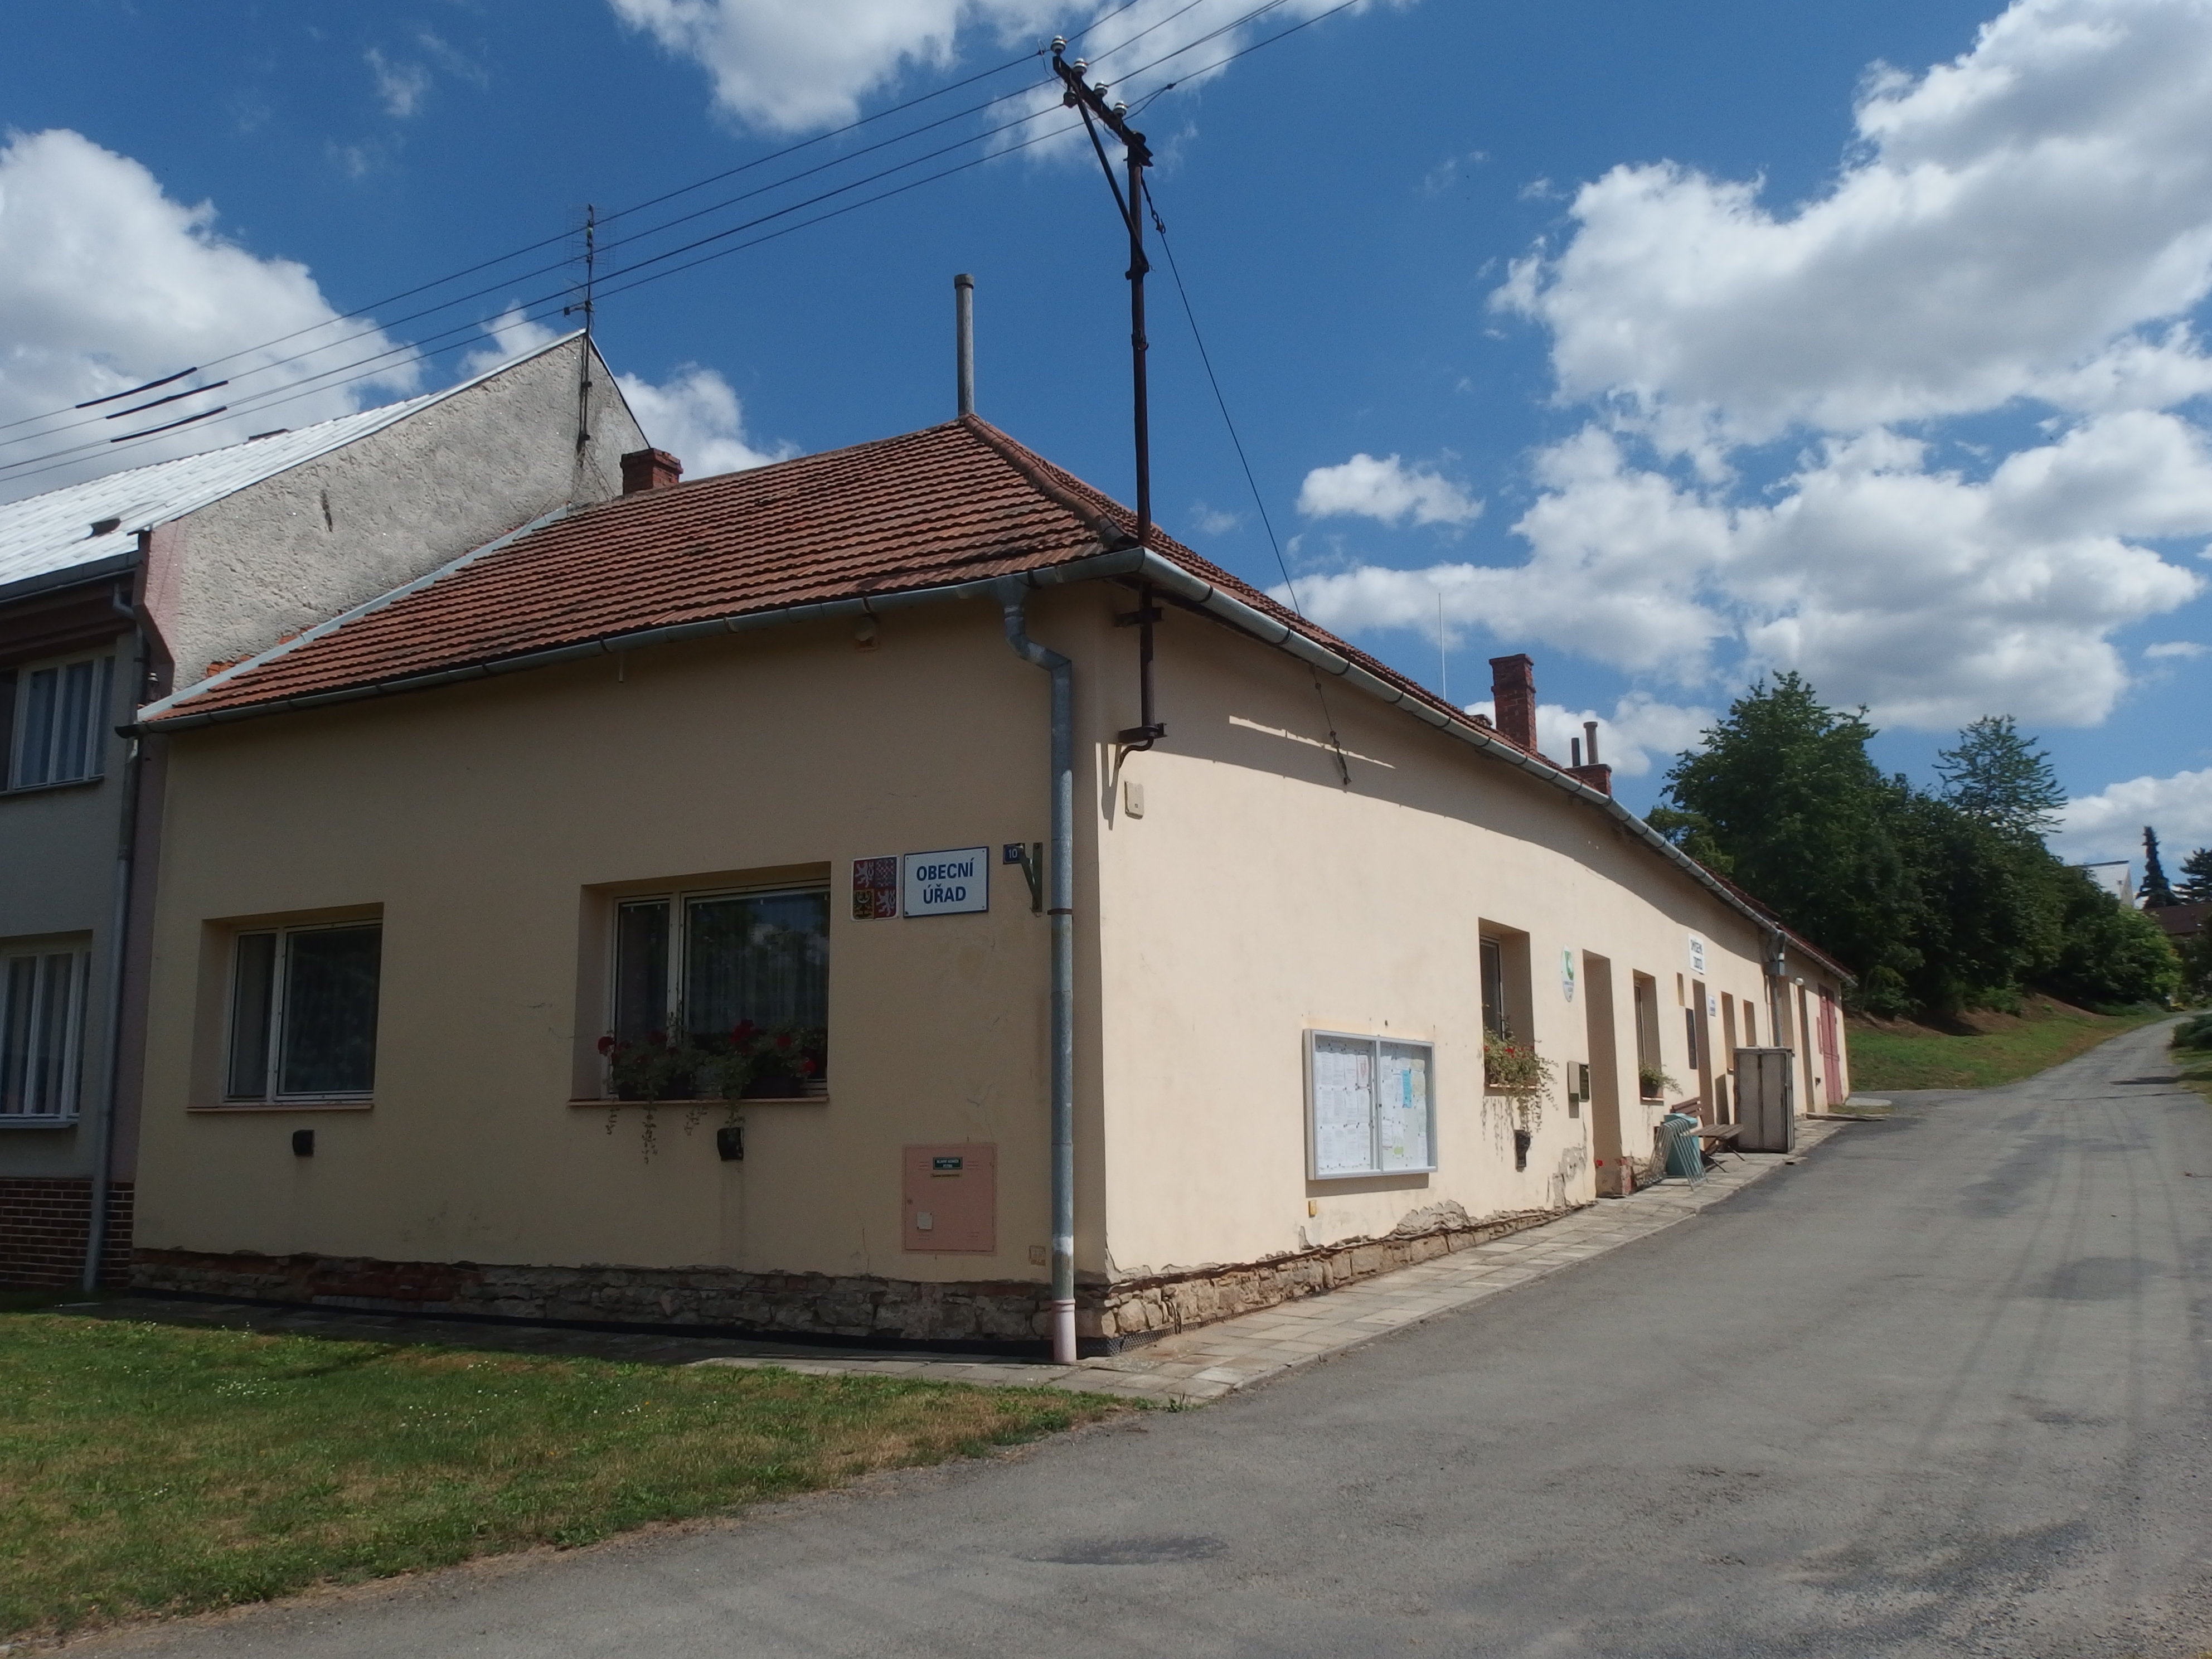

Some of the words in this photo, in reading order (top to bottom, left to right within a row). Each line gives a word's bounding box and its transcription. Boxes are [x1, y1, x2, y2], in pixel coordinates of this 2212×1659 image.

[1008, 848, 1018, 858] 10
[916, 857, 975, 881] OBECNÍ
[923, 883, 966, 904] ÚŘAD
